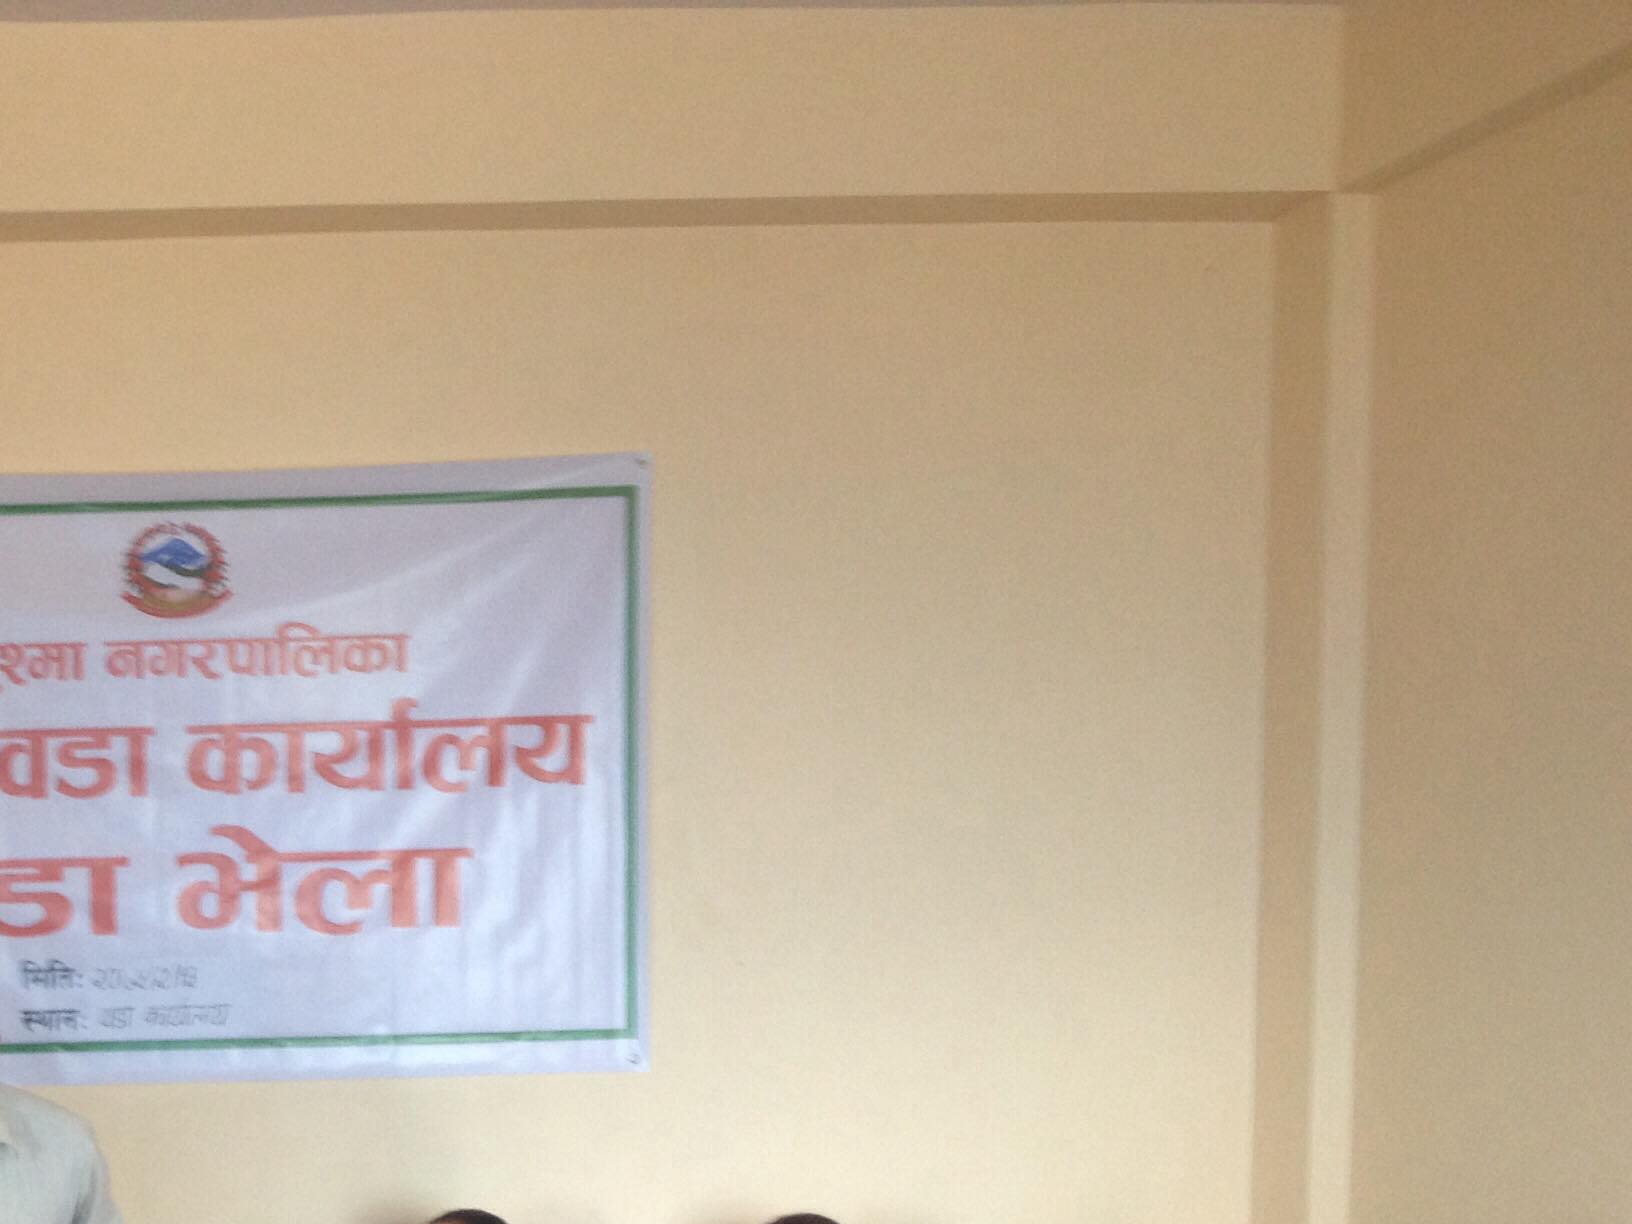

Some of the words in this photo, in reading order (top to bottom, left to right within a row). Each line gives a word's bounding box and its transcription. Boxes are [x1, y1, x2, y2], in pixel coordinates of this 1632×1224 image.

[105, 621, 409, 681] नगरपालिका
[185, 697, 594, 796] कार्यालय
[175, 823, 474, 937] भेला
